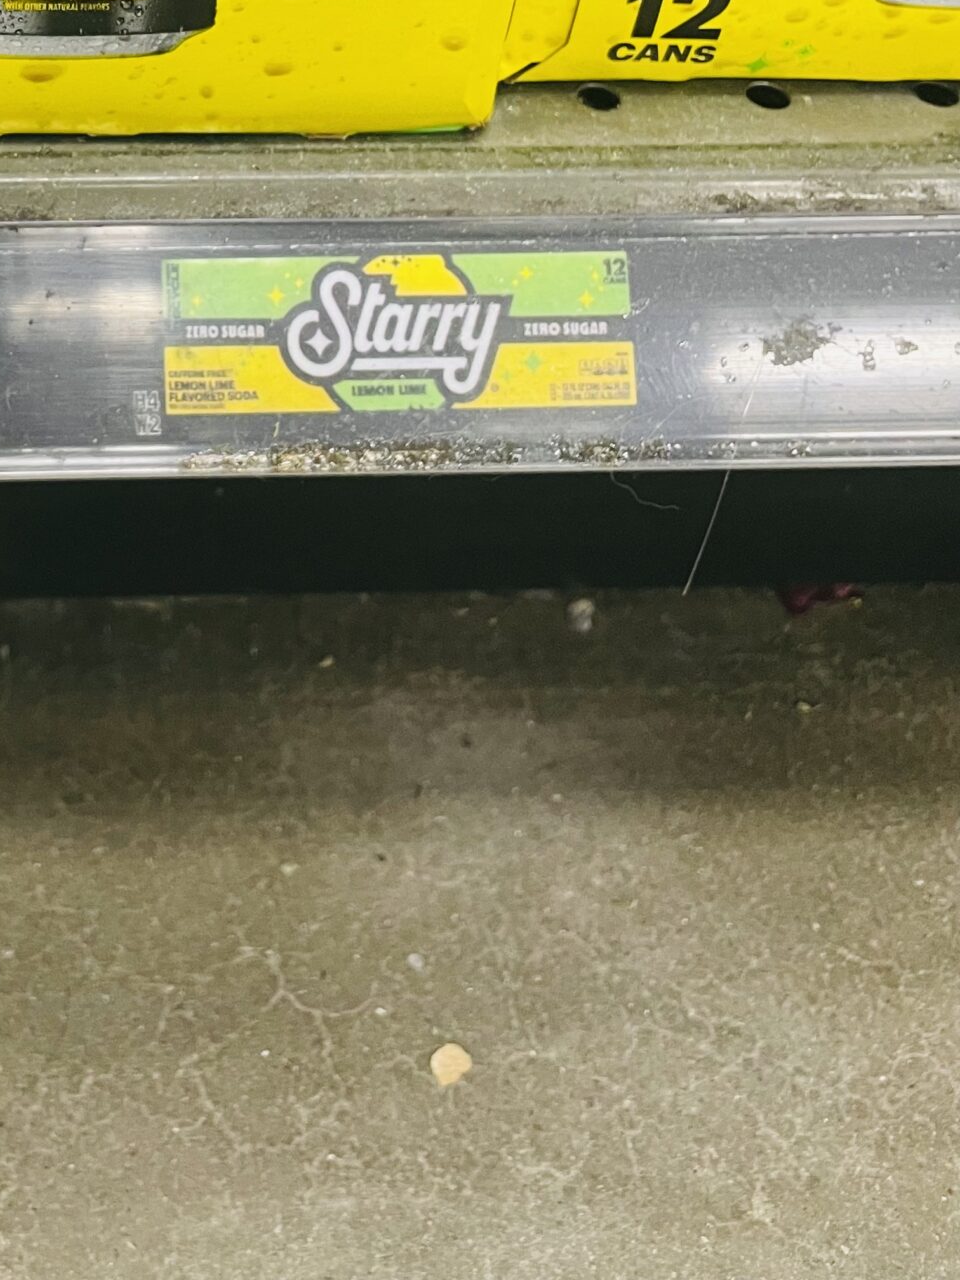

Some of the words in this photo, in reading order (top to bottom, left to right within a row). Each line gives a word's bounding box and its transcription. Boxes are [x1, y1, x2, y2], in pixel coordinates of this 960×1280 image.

[606, 42, 717, 64] CANS
[603, 258, 626, 276] 12
[185, 325, 218, 339] ZERO
[221, 325, 266, 339] SUGAR
[287, 270, 502, 396] Starry
[523, 322, 561, 336] ZERO
[563, 321, 609, 336] SUGAR
[168, 380, 207, 391] LEMON
[209, 380, 235, 390] LIME
[351, 385, 395, 397] LEMON
[398, 384, 428, 395] LIME
[168, 391, 225, 402] FLAVORED
[227, 390, 260, 401] SODA
